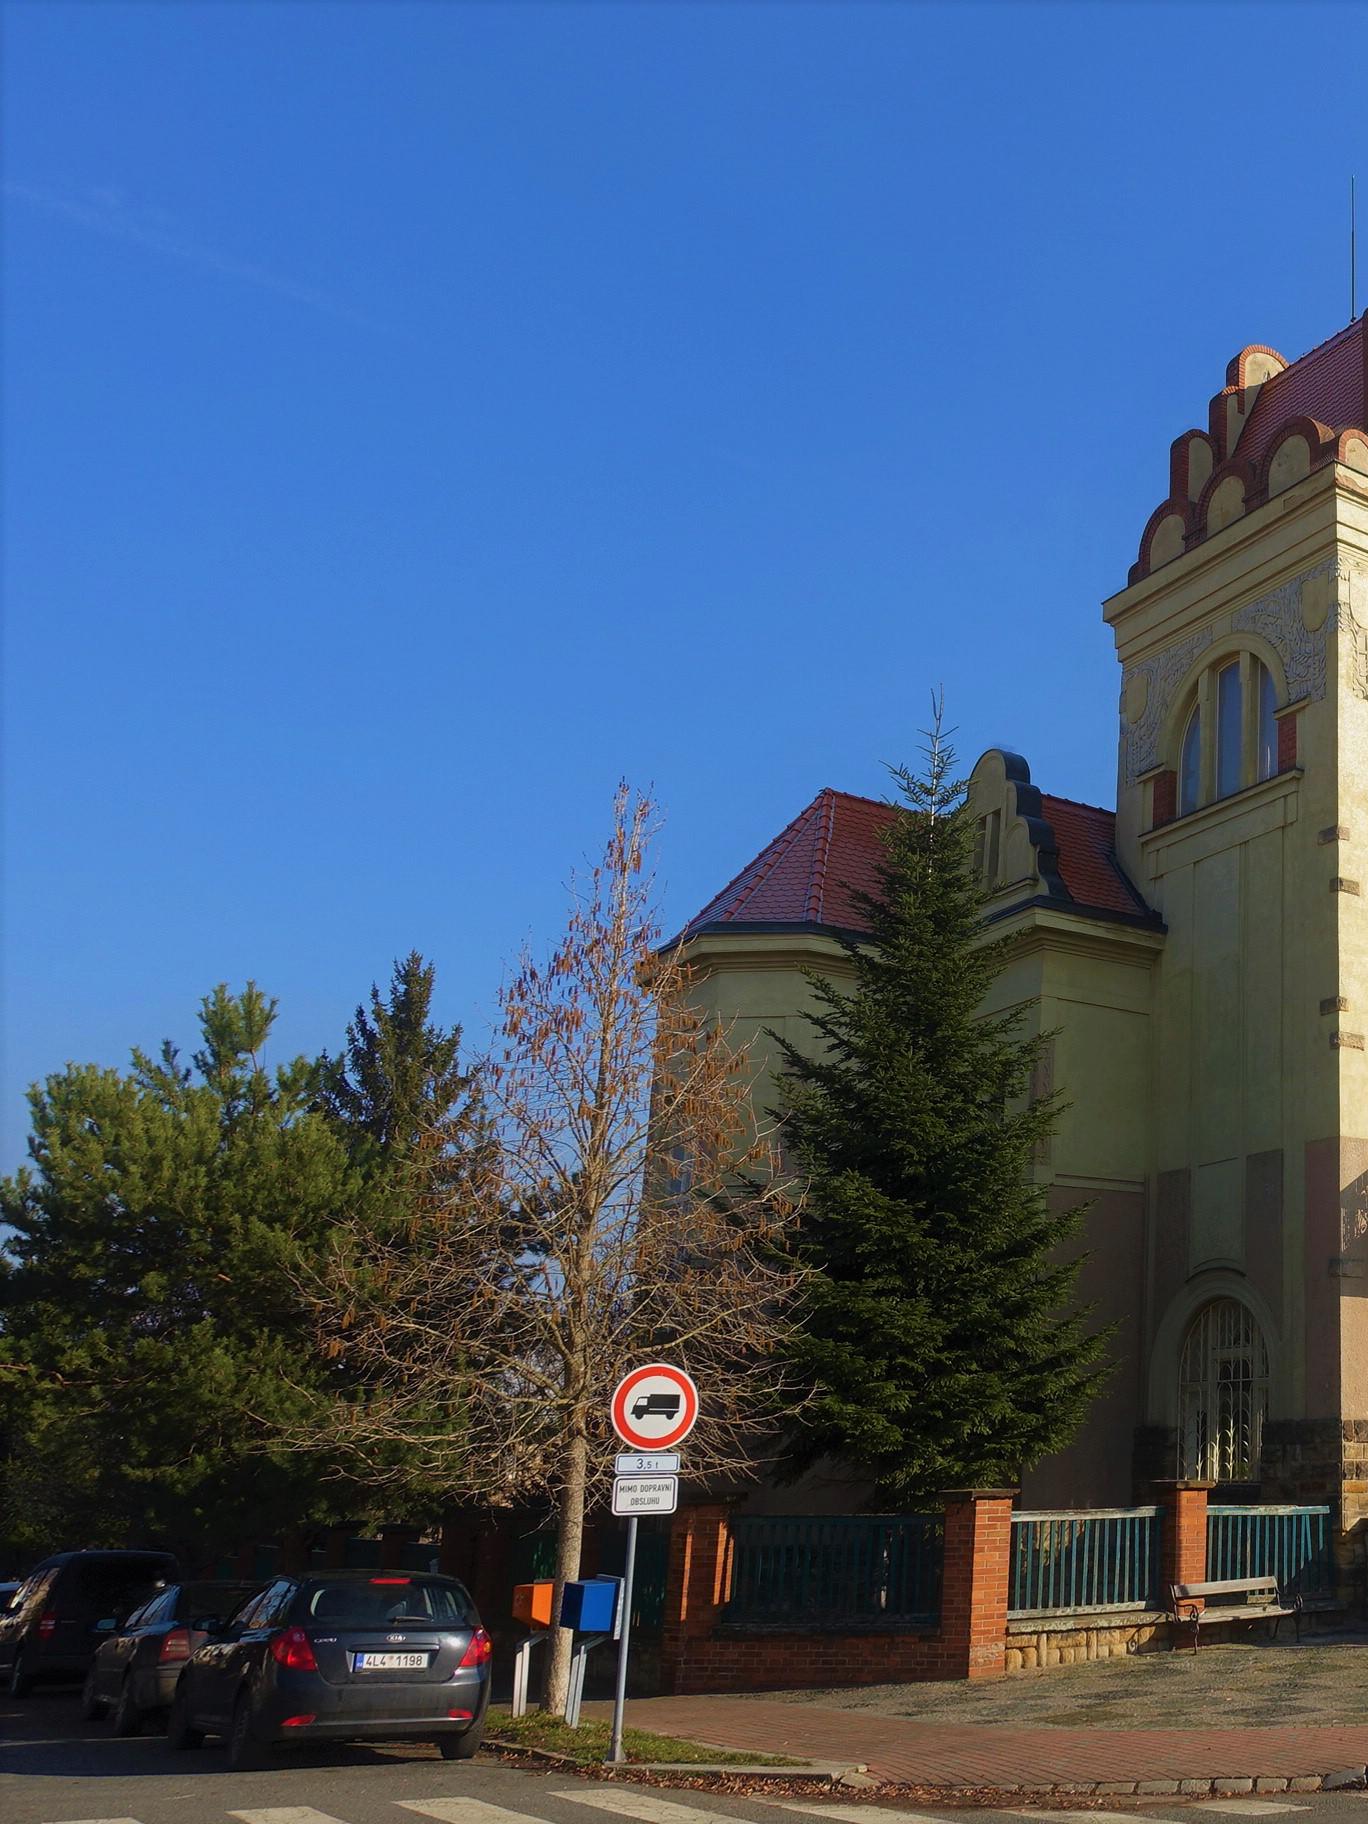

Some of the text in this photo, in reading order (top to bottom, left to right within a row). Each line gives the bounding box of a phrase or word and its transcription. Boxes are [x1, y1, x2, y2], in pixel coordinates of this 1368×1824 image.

[637, 1458, 652, 1470] 3,5
[619, 1485, 638, 1493] MIMO
[630, 1497, 660, 1506] OBSLUHU
[365, 1656, 386, 1667] 4L4
[396, 1655, 423, 1666] 1198
